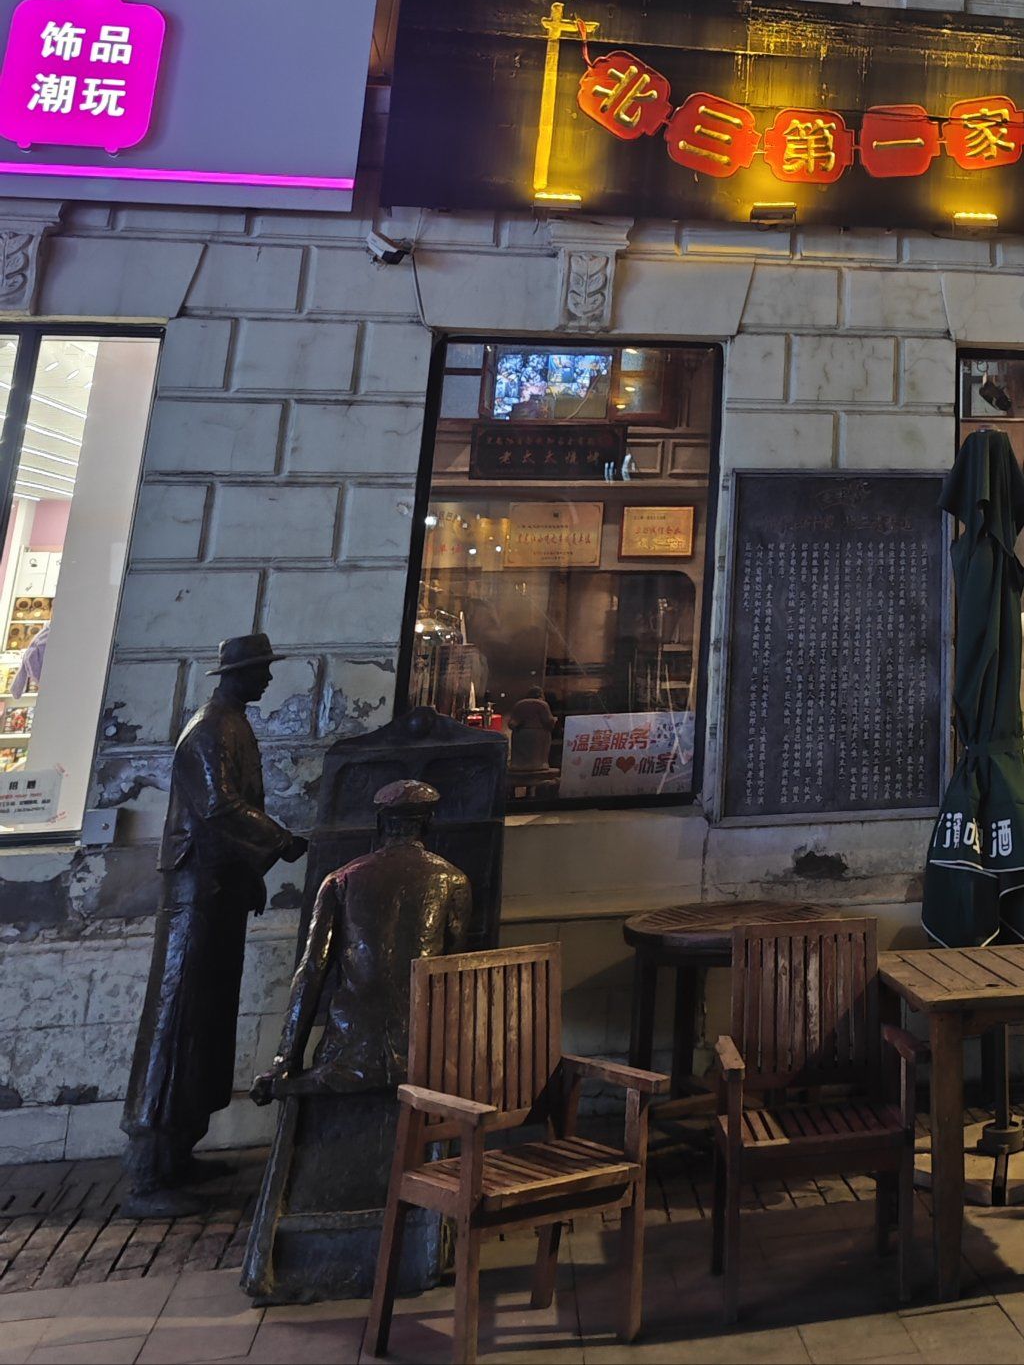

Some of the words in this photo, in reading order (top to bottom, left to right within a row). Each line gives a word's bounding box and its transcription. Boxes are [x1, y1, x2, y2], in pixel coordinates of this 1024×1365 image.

[41, 21, 133, 65] 饰品
[27, 74, 126, 117] 潮玩
[592, 65, 1015, 174] 北三第一家
